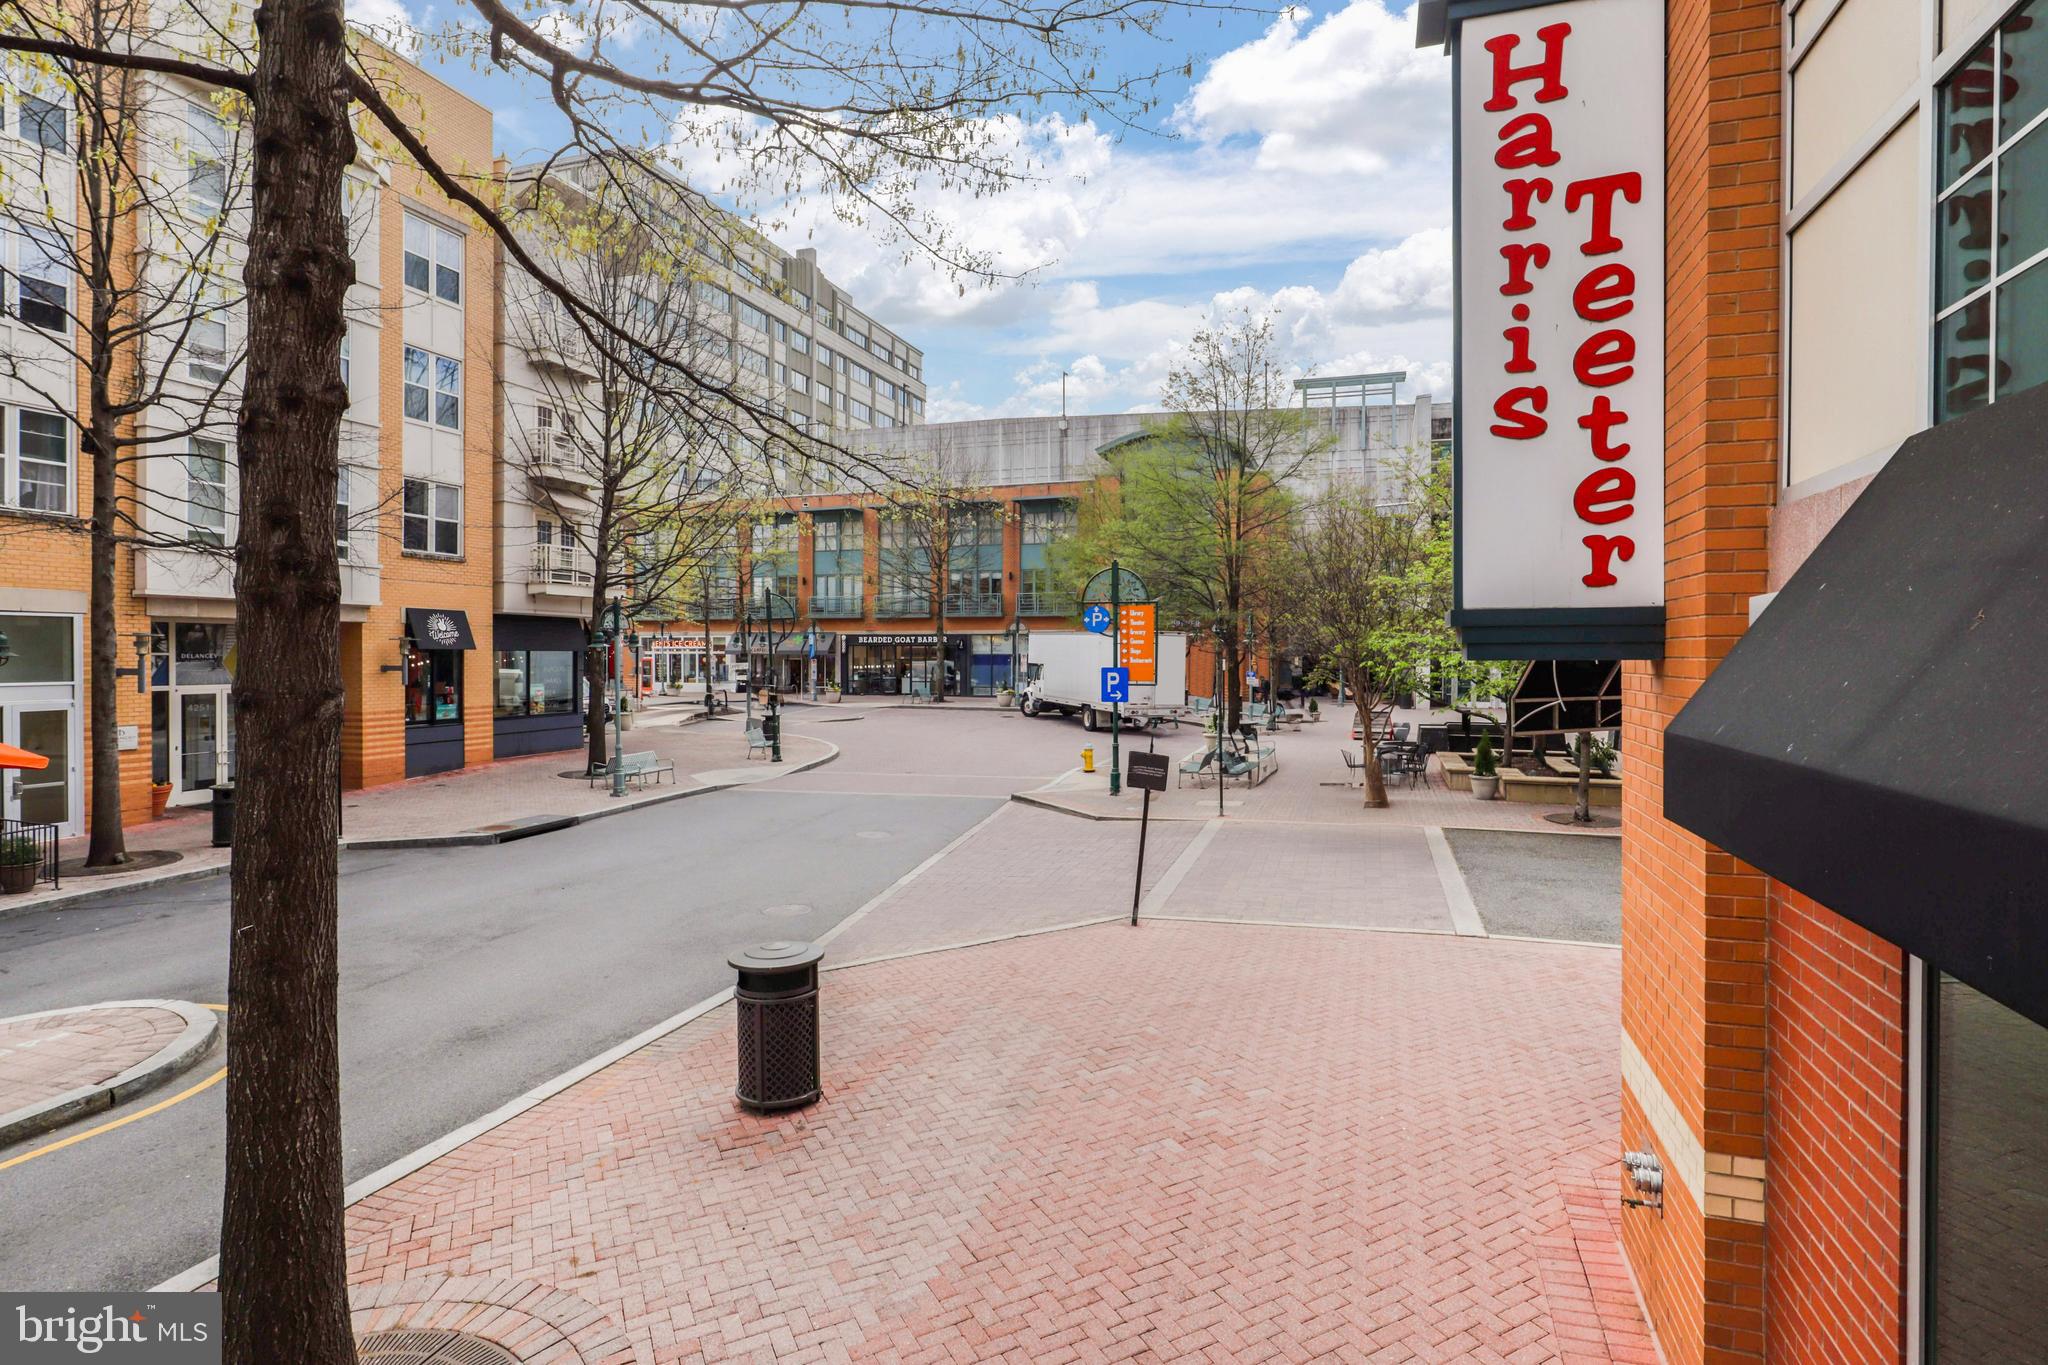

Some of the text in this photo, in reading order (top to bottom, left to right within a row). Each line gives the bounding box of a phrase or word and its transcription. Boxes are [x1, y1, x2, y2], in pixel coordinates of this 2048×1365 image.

[1482, 21, 1643, 589] Harris Teeter
[1092, 613, 1103, 627] P
[428, 630, 460, 641] Welcome
[858, 636, 948, 644] BEARDED GOAT BARBR
[180, 652, 218, 660] DELANCEY
[1107, 672, 1120, 693] P
